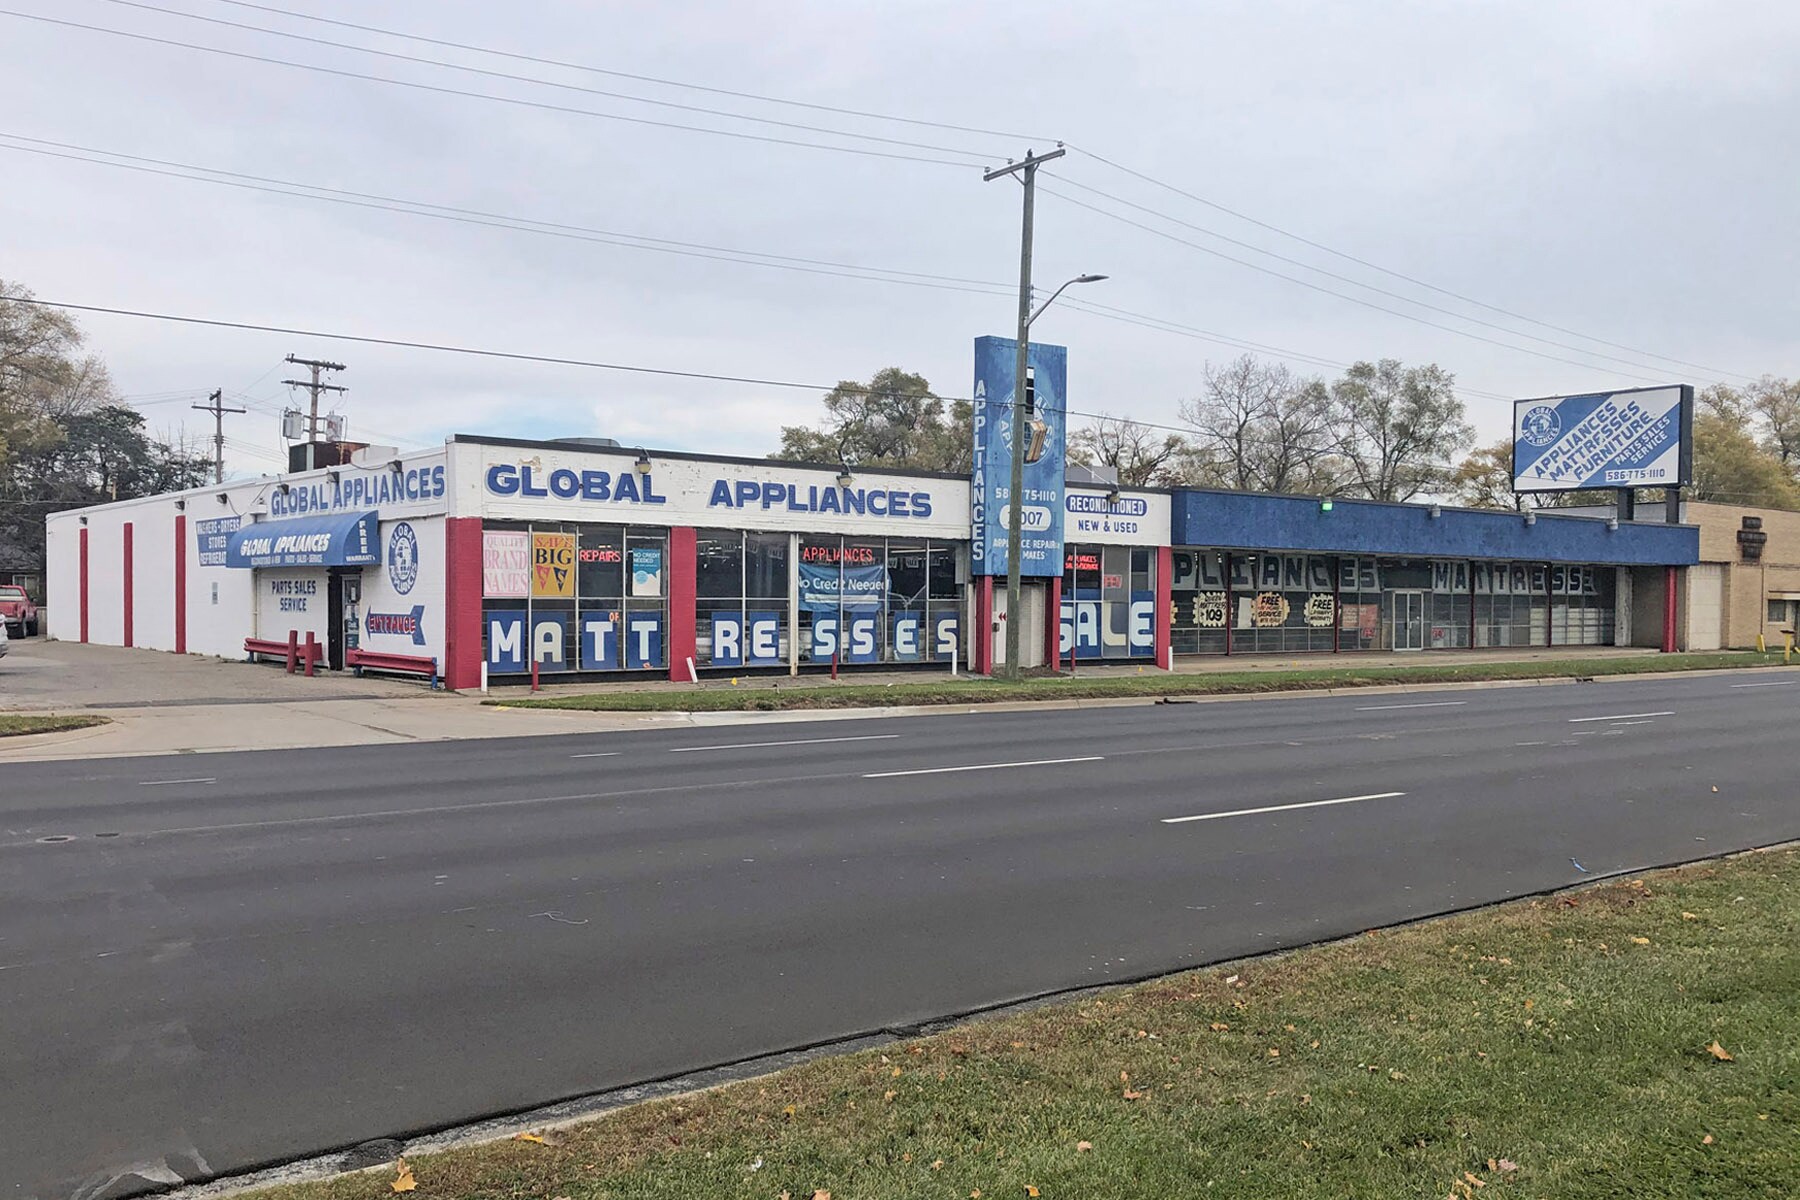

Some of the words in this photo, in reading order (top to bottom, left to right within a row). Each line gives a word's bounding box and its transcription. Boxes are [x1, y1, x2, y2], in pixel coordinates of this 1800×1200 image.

[1527, 406, 1552, 418] GLOBAL
[1534, 401, 1618, 478] APPLIANCES
[1549, 401, 1641, 482] MATTRESSES
[1573, 410, 1653, 480] FURNITURE
[1615, 439, 1642, 465] PARTS
[1642, 416, 1671, 443] SALES
[1632, 431, 1668, 464] SERVICE
[972, 380, 986, 560] APPLIANCES
[271, 484, 329, 515] GLOBAL
[333, 465, 445, 509] APPLIANCES
[487, 464, 666, 504] GLOBAL
[709, 479, 932, 518] APPLIANCES
[1078, 519, 1100, 531] NEW
[1103, 520, 1111, 532] &
[1113, 521, 1138, 533] USED
[240, 539, 272, 556] GLOBAL
[273, 533, 331, 553] APPLIANCES
[358, 520, 368, 553] FREE
[391, 526, 416, 549] GLOBAL
[486, 535, 525, 548] QUALITY
[536, 537, 572, 548] SAVE
[484, 549, 528, 570] BRAND
[536, 547, 572, 565] BIG
[579, 550, 621, 562] REPAIRS
[803, 546, 874, 562] APPLIANCES
[271, 581, 292, 594] PARTS
[294, 580, 316, 594] SALES
[484, 572, 528, 592] NAMES
[280, 597, 307, 612] SERVICE
[1261, 596, 1280, 605] FREE
[1312, 599, 1332, 610] FREE
[369, 615, 416, 634] ENTRANCE
[1060, 601, 1154, 653] SALE
